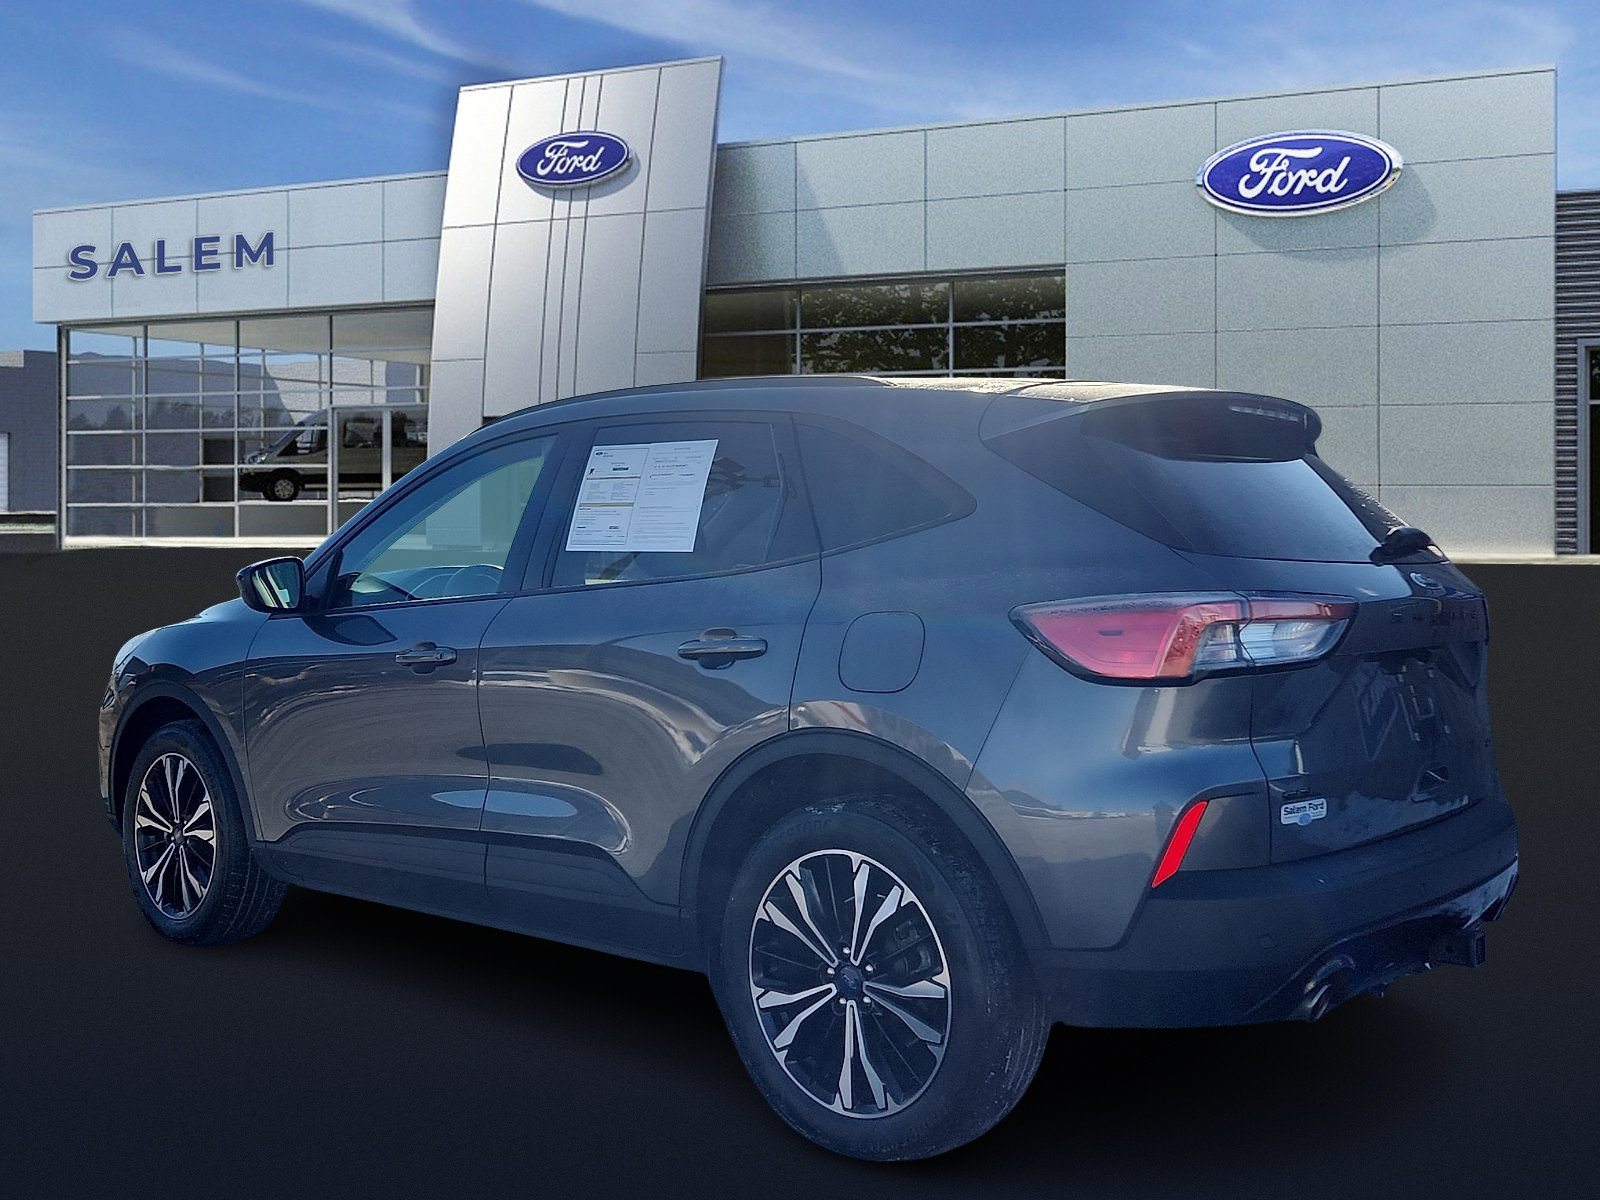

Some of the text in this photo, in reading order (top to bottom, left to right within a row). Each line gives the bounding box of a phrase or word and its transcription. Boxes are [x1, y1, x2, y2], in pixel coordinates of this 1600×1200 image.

[537, 140, 604, 175] Ford
[1238, 147, 1350, 198] Ford
[68, 231, 275, 280] SALEM
[1283, 805, 1307, 815] Salem
[1308, 801, 1324, 811] Ford
